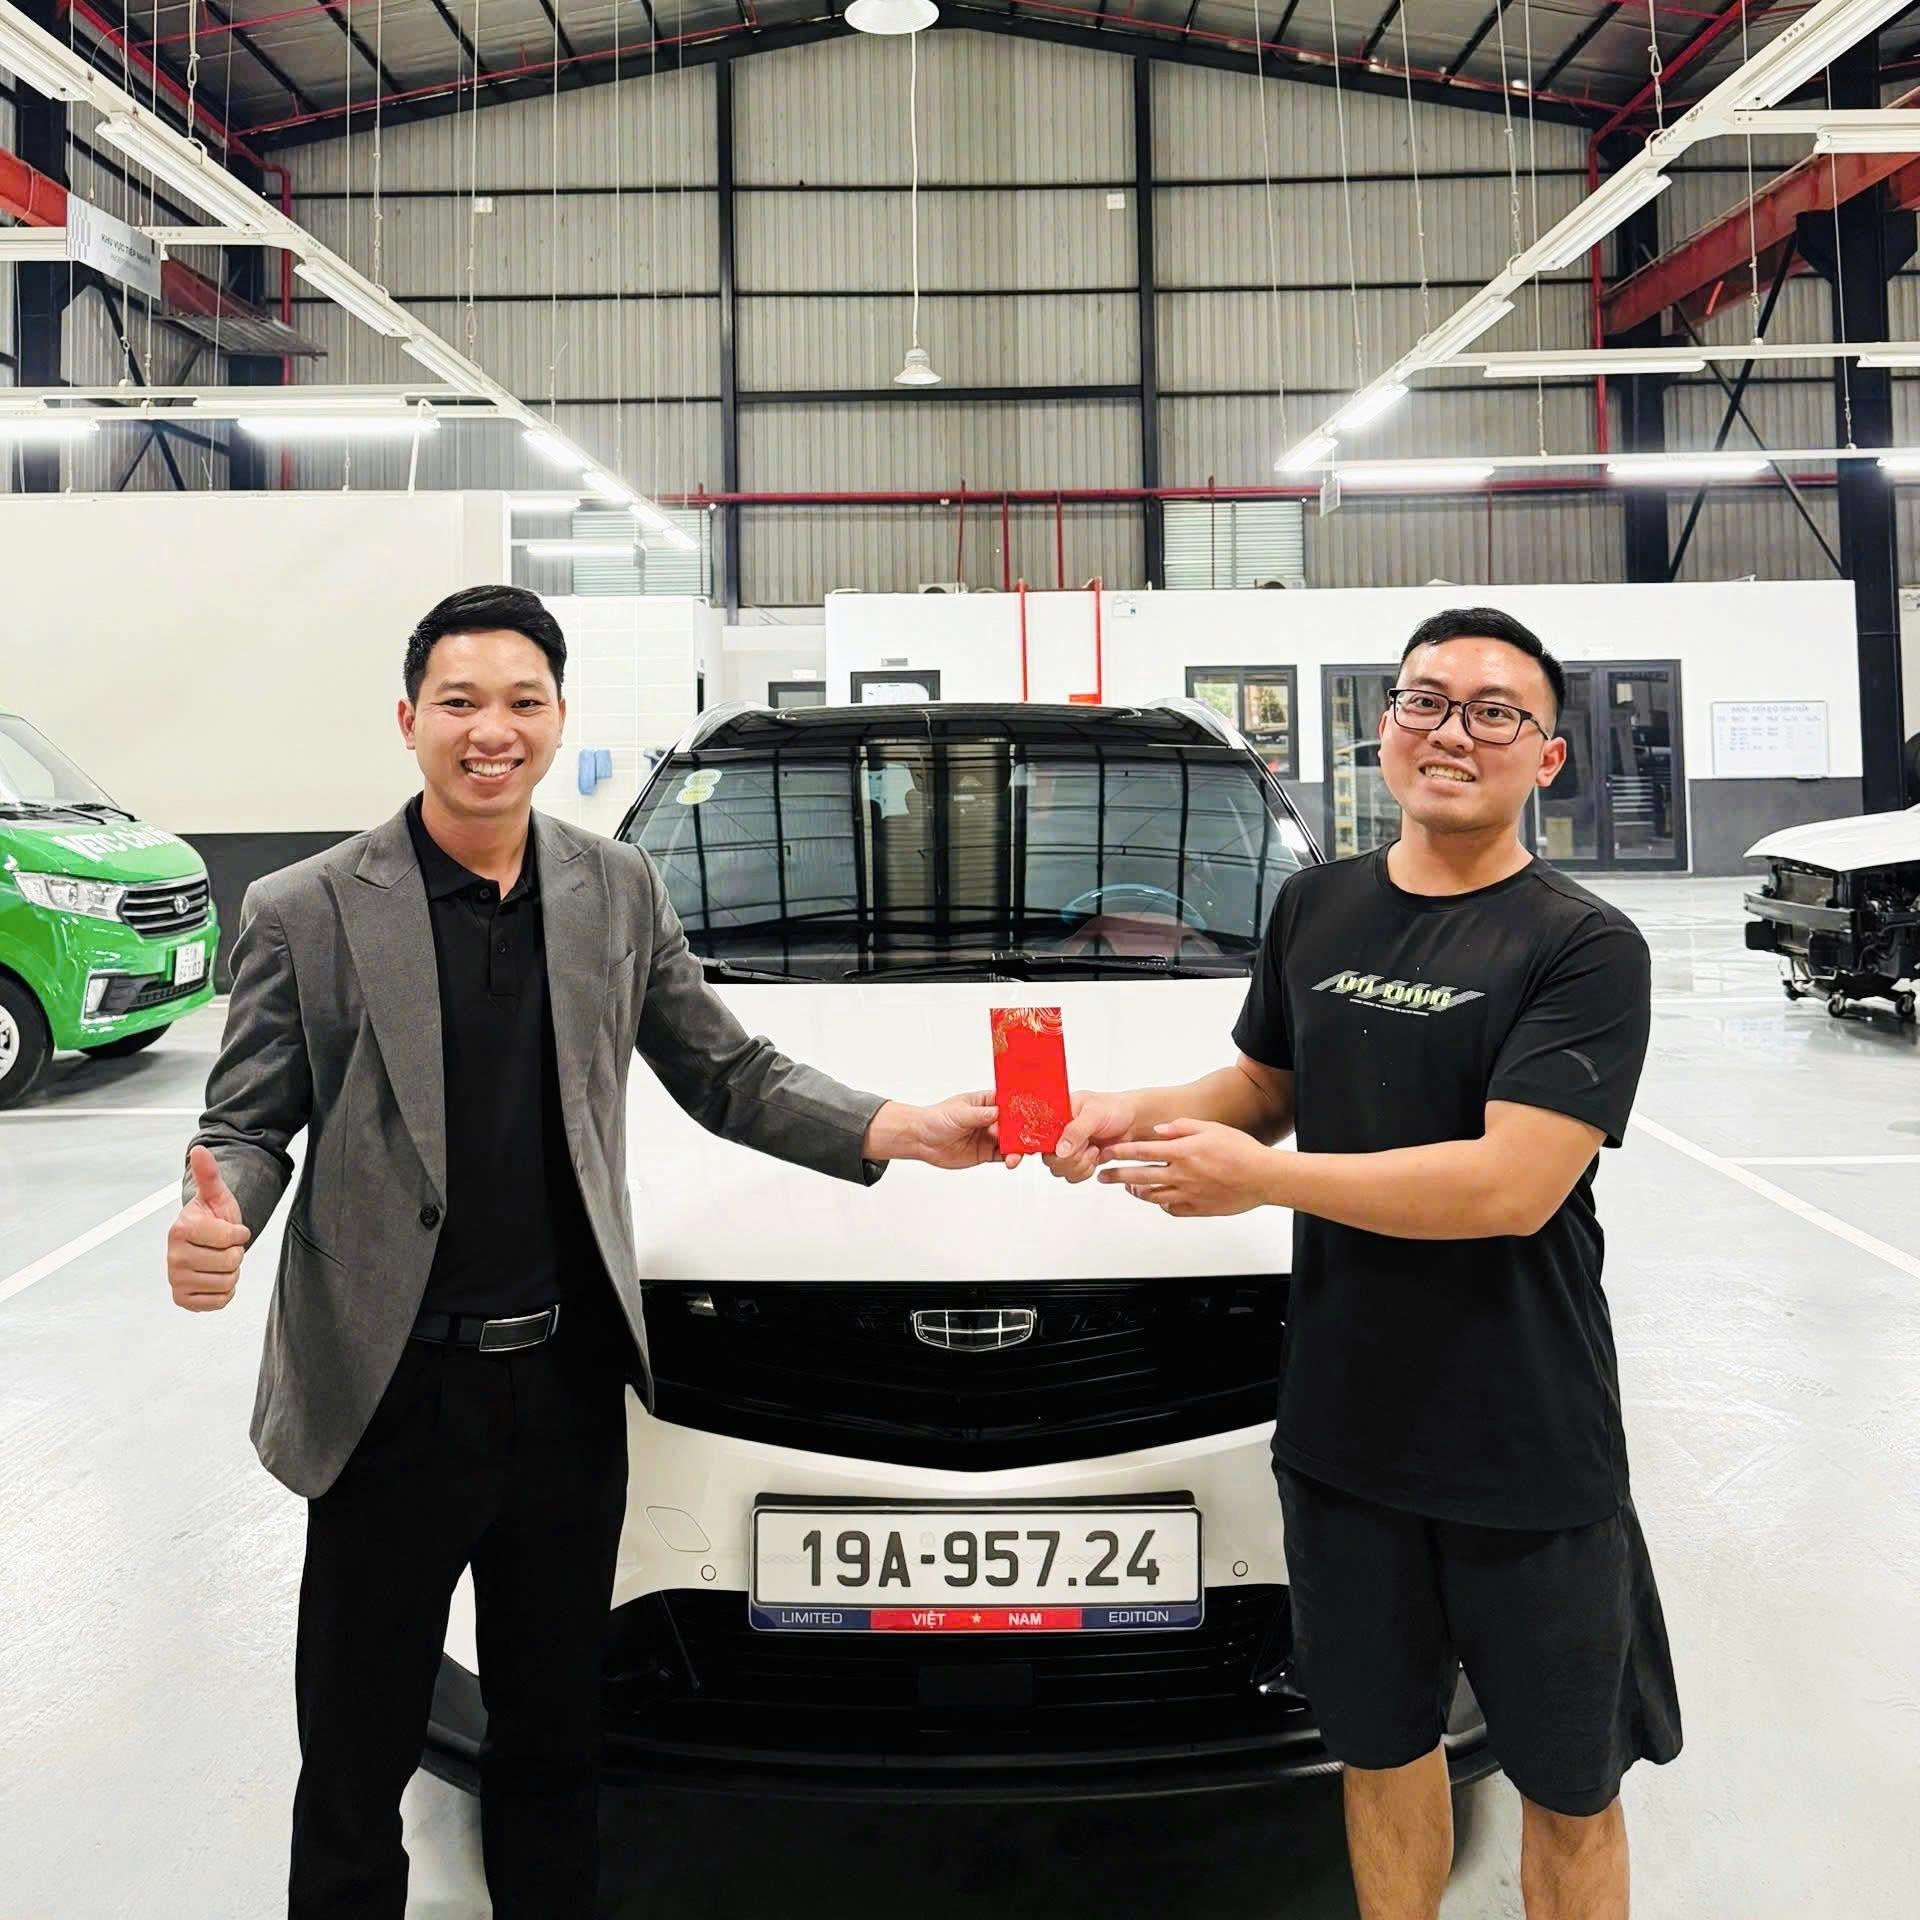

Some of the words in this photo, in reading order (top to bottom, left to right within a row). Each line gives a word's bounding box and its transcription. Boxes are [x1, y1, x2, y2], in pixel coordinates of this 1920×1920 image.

[1336, 975, 1374, 994] ANTA
[1382, 983, 1451, 1007] RUNNING
[803, 1529, 1160, 1588] 19A-957.24
[781, 1611, 843, 1624] LIMITED
[911, 1610, 946, 1629] VIỆT
[1008, 1612, 1042, 1625] NAM
[1108, 1610, 1169, 1623] EDITION
